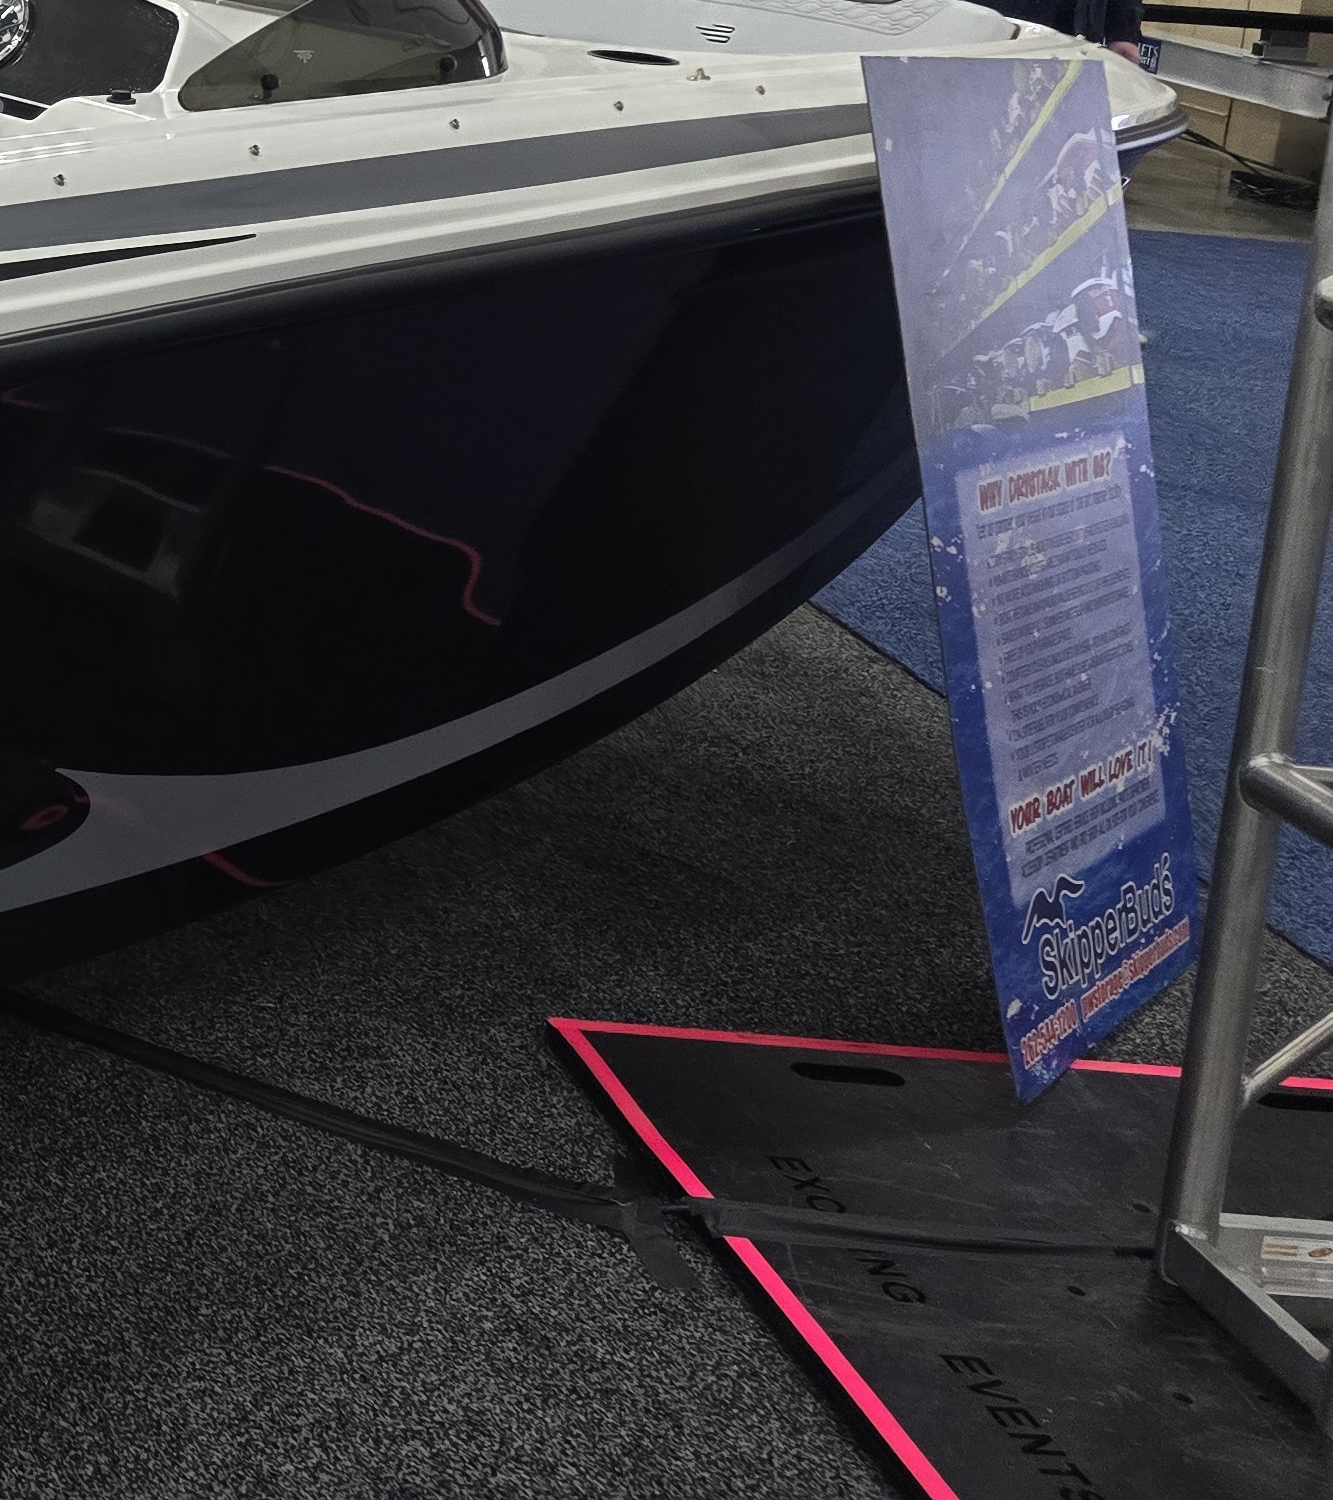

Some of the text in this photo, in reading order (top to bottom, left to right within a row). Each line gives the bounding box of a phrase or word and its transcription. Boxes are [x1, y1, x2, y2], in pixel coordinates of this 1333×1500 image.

[1010, 797, 1041, 834] YOUR
[1046, 779, 1076, 815] BOAT
[1080, 765, 1105, 798] WILL
[1108, 749, 1134, 783] LOVE
